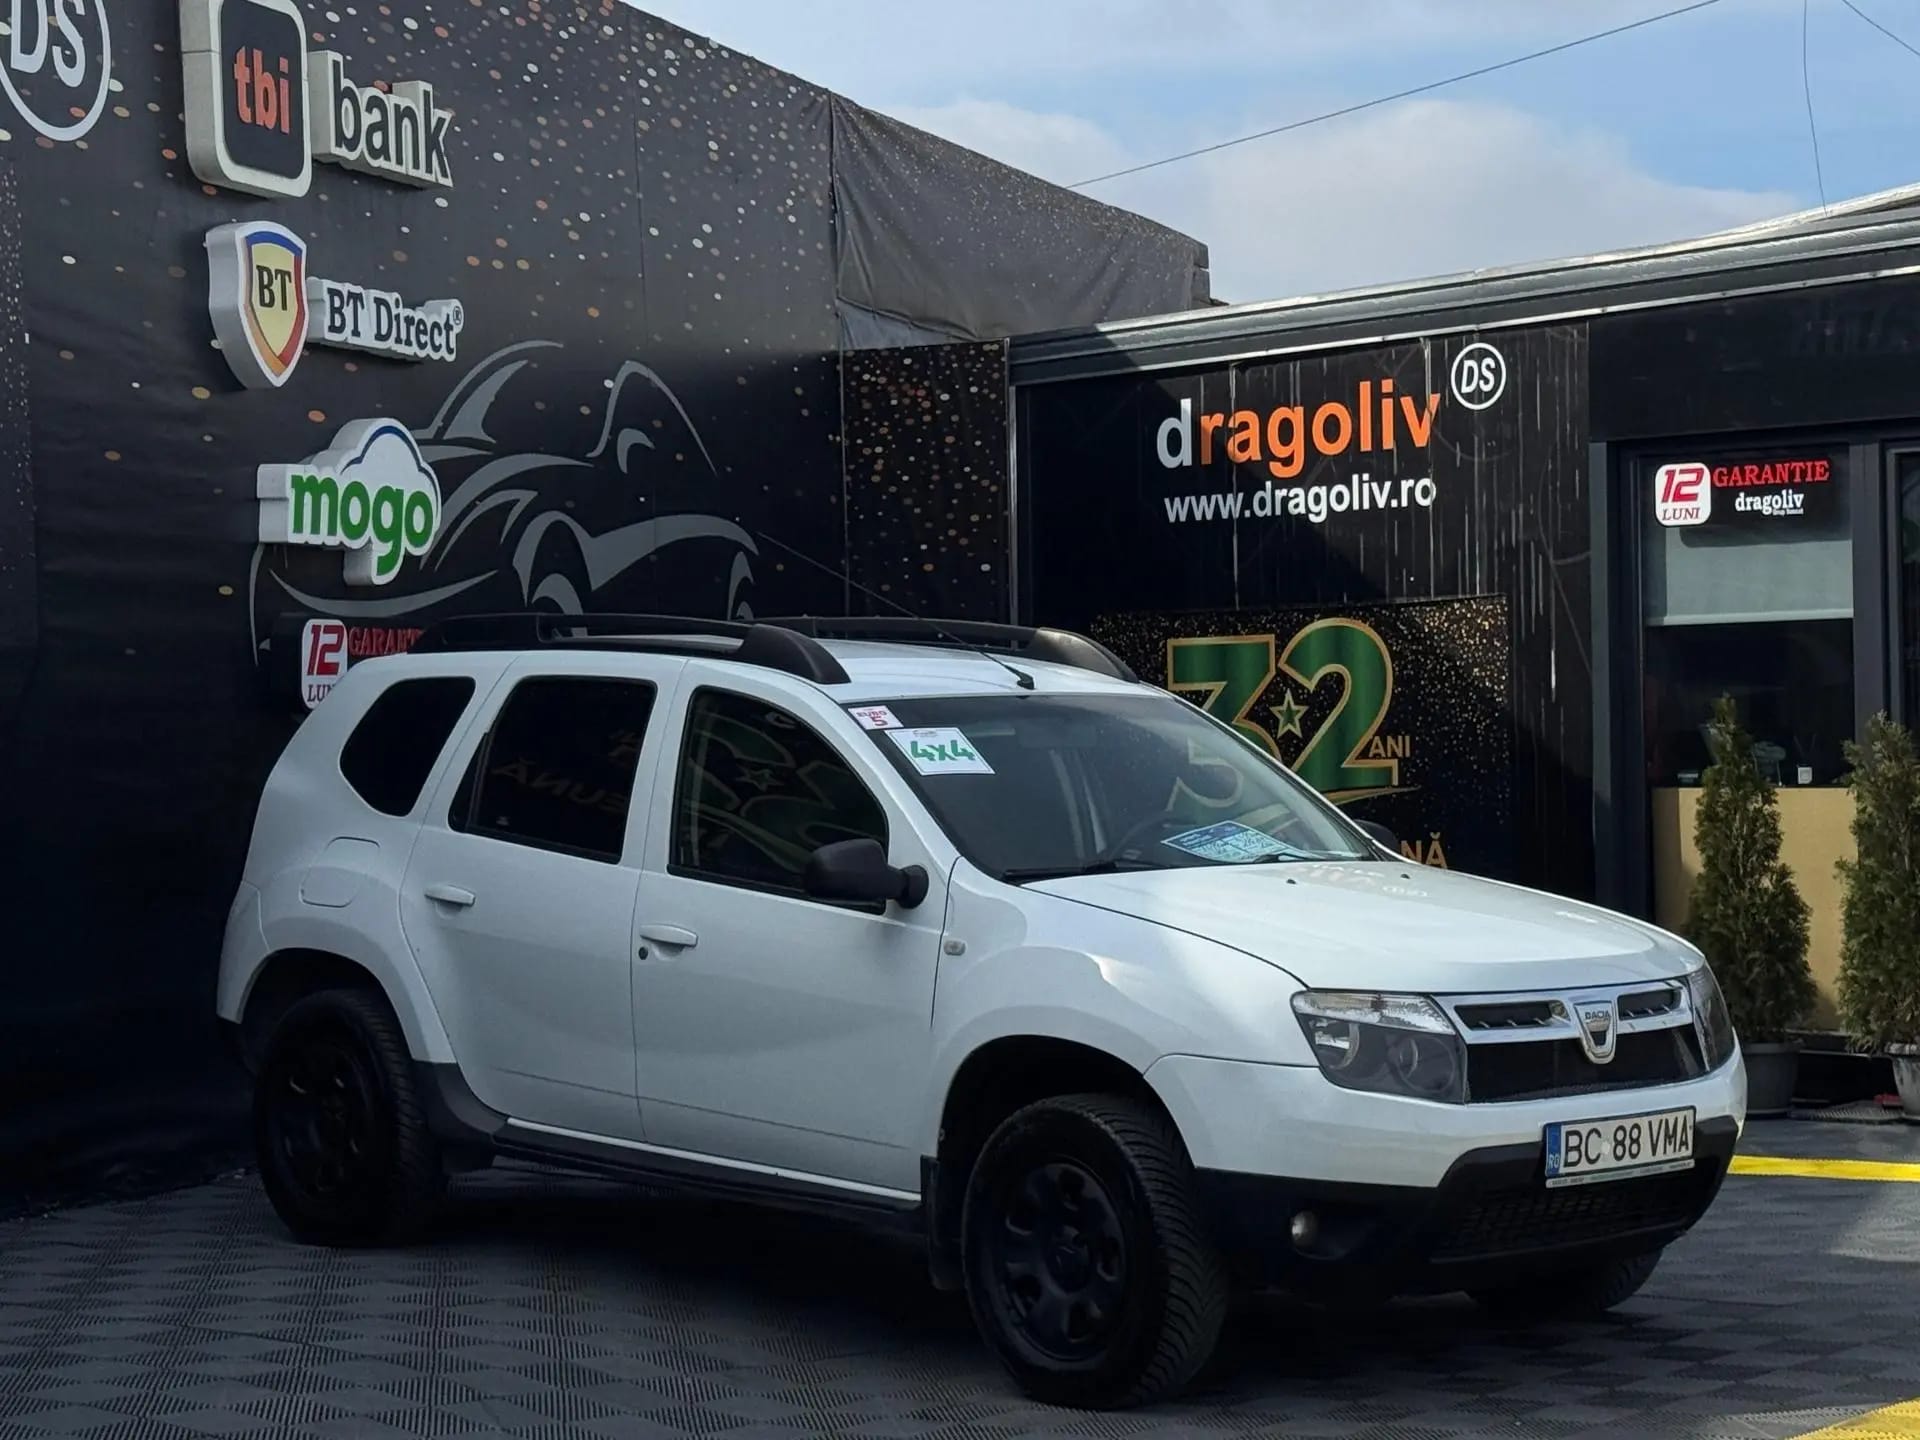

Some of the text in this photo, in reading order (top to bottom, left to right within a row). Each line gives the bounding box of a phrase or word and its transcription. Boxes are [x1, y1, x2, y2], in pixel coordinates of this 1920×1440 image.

[11, 0, 86, 87] DS
[234, 46, 290, 134] tbi
[332, 60, 450, 180] bank
[256, 265, 292, 311] BT
[327, 287, 365, 338] BT
[1461, 357, 1496, 394] DS
[1156, 378, 1441, 479] dragoliv
[1164, 473, 1437, 523] www.dragoliv.ro
[1661, 460, 1830, 503] 12 GARANTIE
[1735, 489, 1804, 515] dragoliv
[291, 474, 434, 576] mogo
[1661, 507, 1700, 521] LUNI
[306, 624, 345, 676] 12
[870, 716, 888, 726] 5
[1167, 617, 1399, 794] 32
[1368, 735, 1411, 758] ANI
[1563, 1115, 1690, 1168] BC 88 VMA
